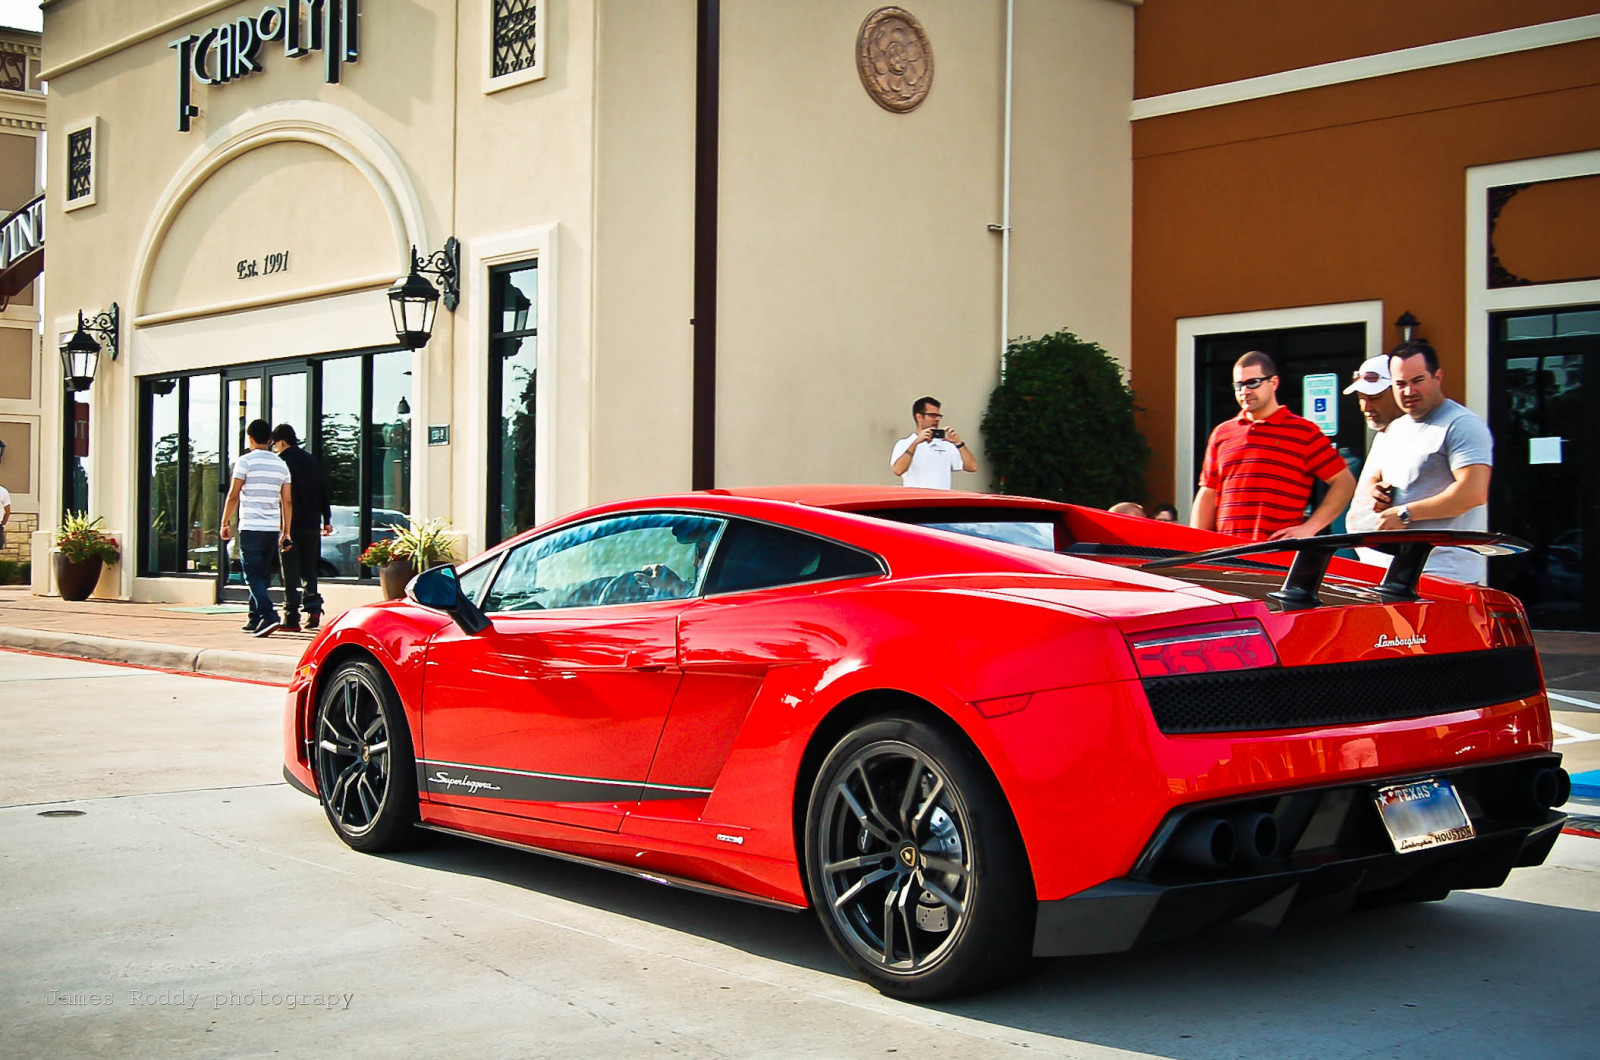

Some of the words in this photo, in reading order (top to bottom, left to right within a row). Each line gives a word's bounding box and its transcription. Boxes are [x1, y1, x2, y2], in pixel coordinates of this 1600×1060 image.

[237, 259, 259, 280] Est.
[262, 250, 289, 276] 1991
[1374, 634, 1427, 649] Lamborghini
[428, 771, 501, 794] Superleggera
[1395, 785, 1431, 803] TEXAS
[1434, 826, 1474, 844] HOUSTON
